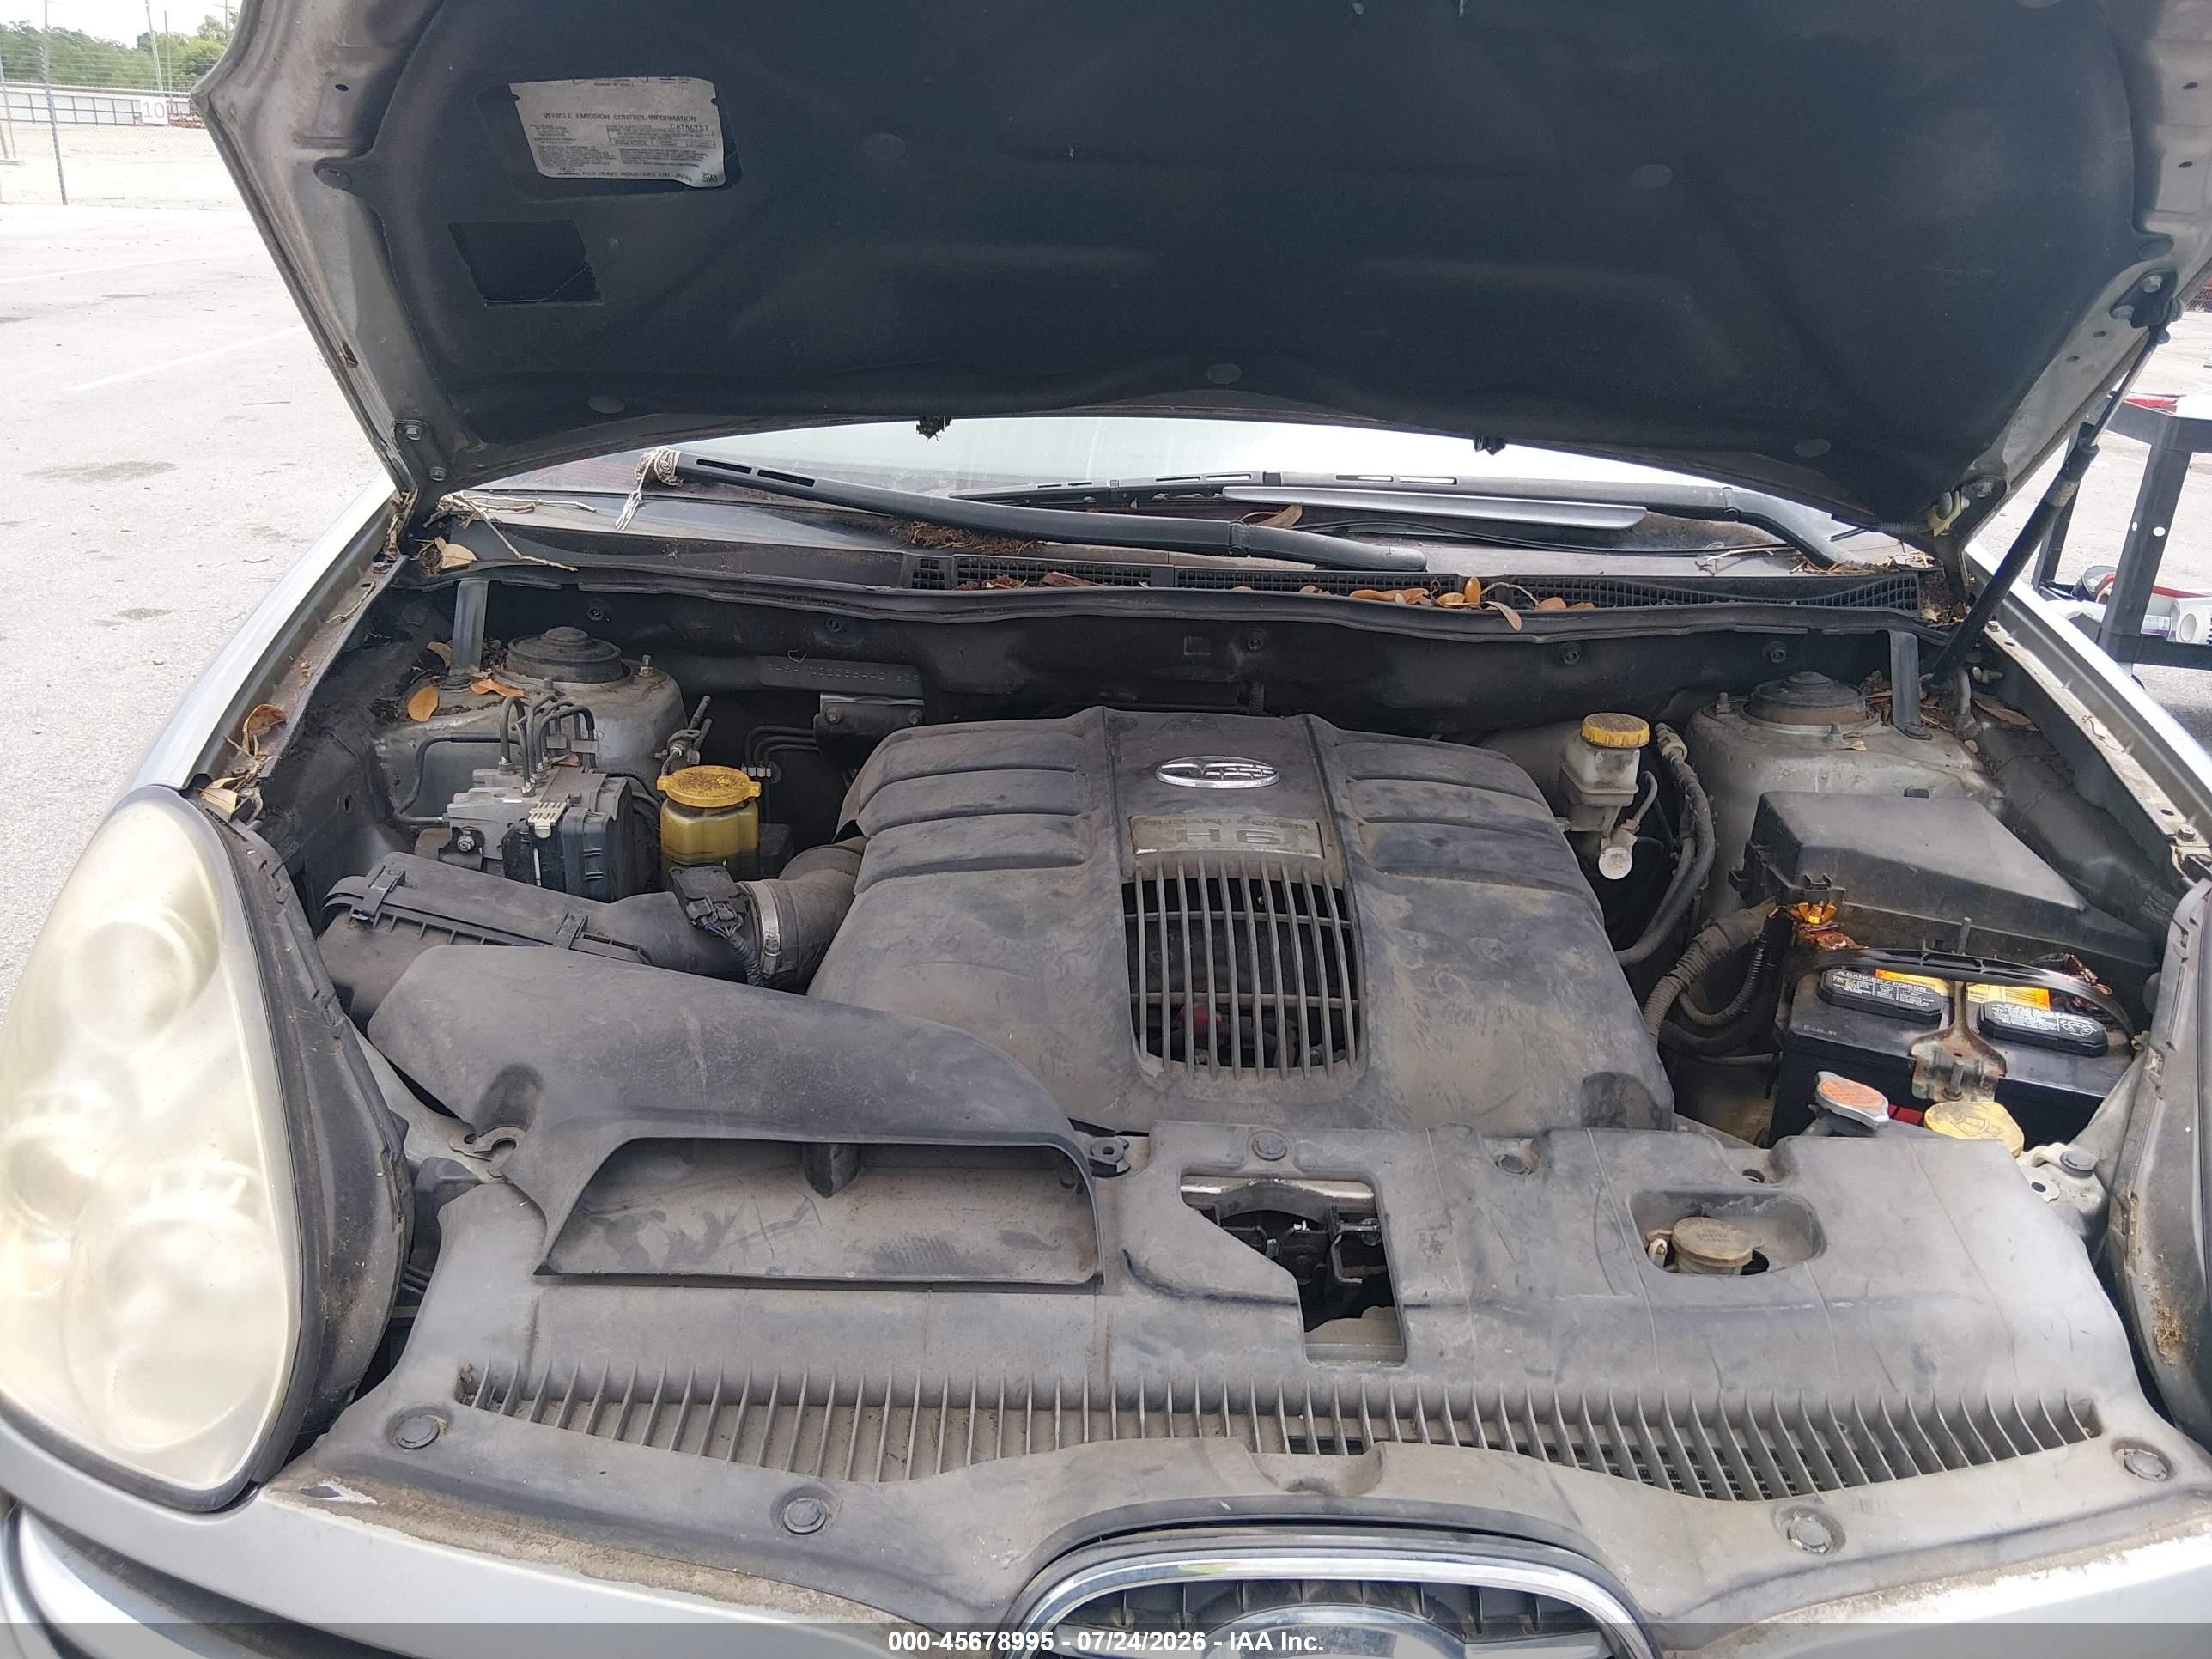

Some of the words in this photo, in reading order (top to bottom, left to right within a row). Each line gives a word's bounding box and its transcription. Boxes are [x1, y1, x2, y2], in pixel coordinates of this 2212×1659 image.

[143, 101, 166, 118] 10
[1846, 972, 1883, 984] DANGER
[1892, 981, 1927, 993] POISON
